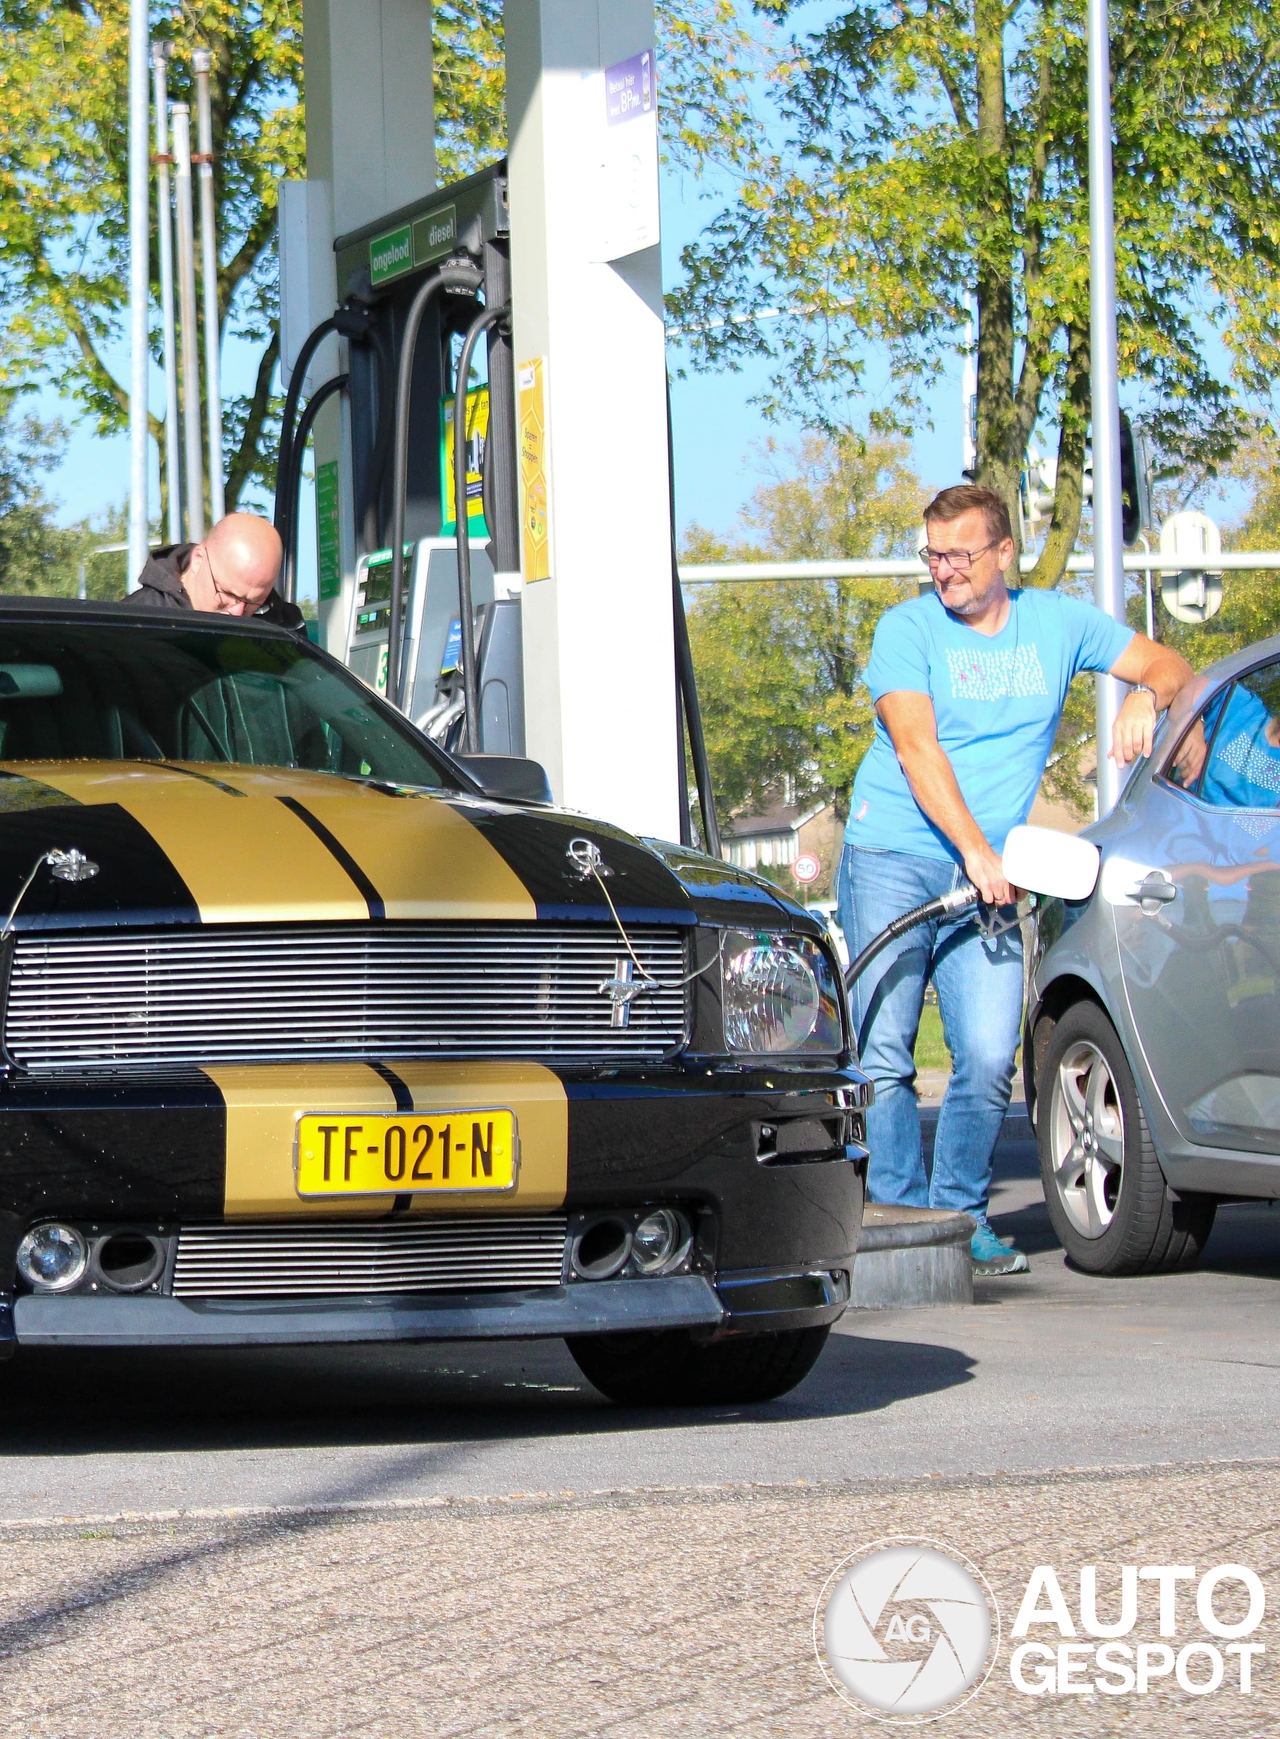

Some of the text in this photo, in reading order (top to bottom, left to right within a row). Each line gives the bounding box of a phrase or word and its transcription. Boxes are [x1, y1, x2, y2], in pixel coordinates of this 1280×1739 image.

[609, 75, 635, 95] Betaal hier
[429, 218, 454, 247] diesel
[373, 238, 409, 271] ongelood
[524, 427, 537, 442] Sparen
[521, 446, 538, 464] Shoppen
[797, 863, 814, 874] 50
[318, 1122, 494, 1182] TF-021-N
